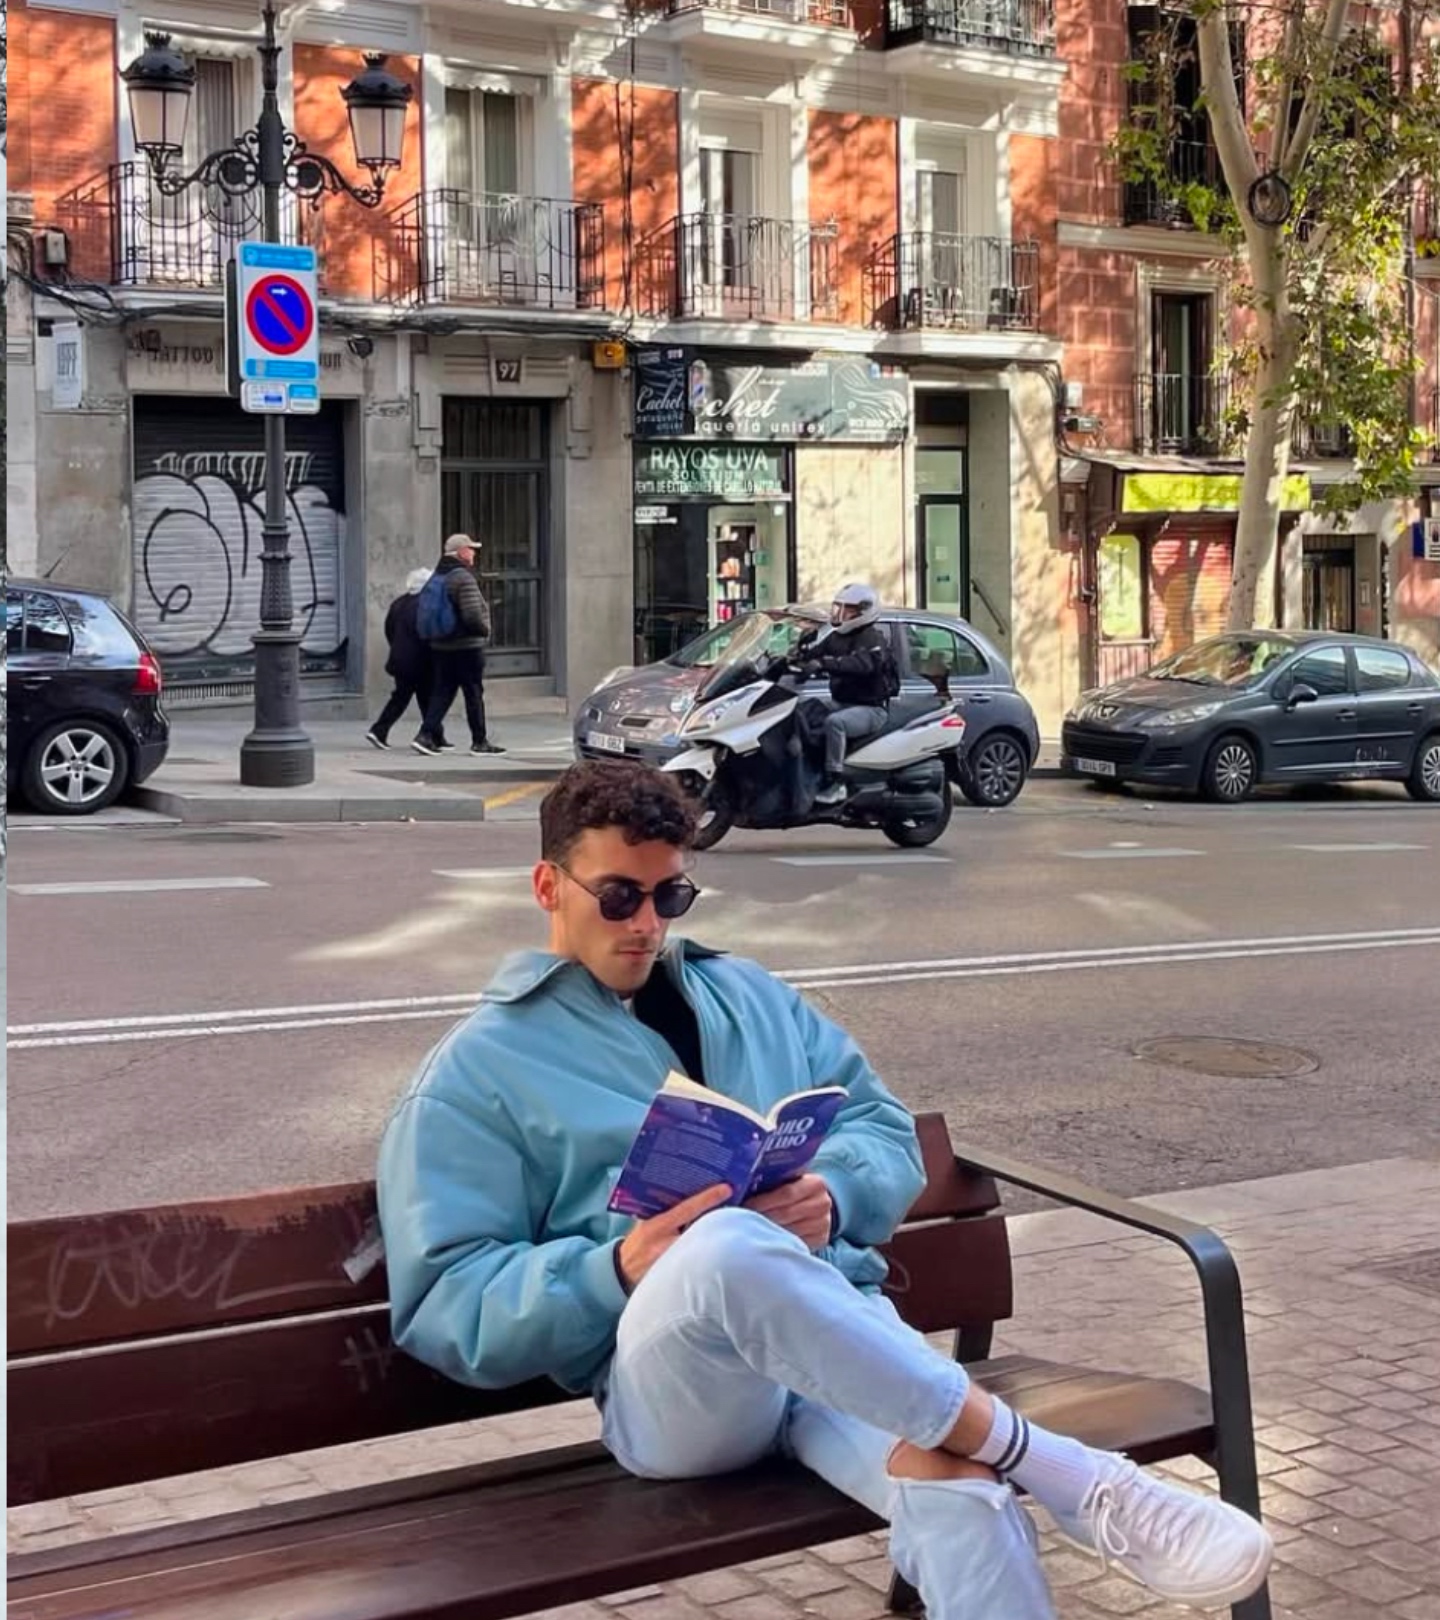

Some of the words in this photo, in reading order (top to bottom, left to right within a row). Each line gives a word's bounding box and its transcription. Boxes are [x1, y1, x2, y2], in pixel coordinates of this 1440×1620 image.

[499, 361, 518, 379] 97
[651, 447, 719, 470] RAYOS
[725, 447, 769, 471] UVA
